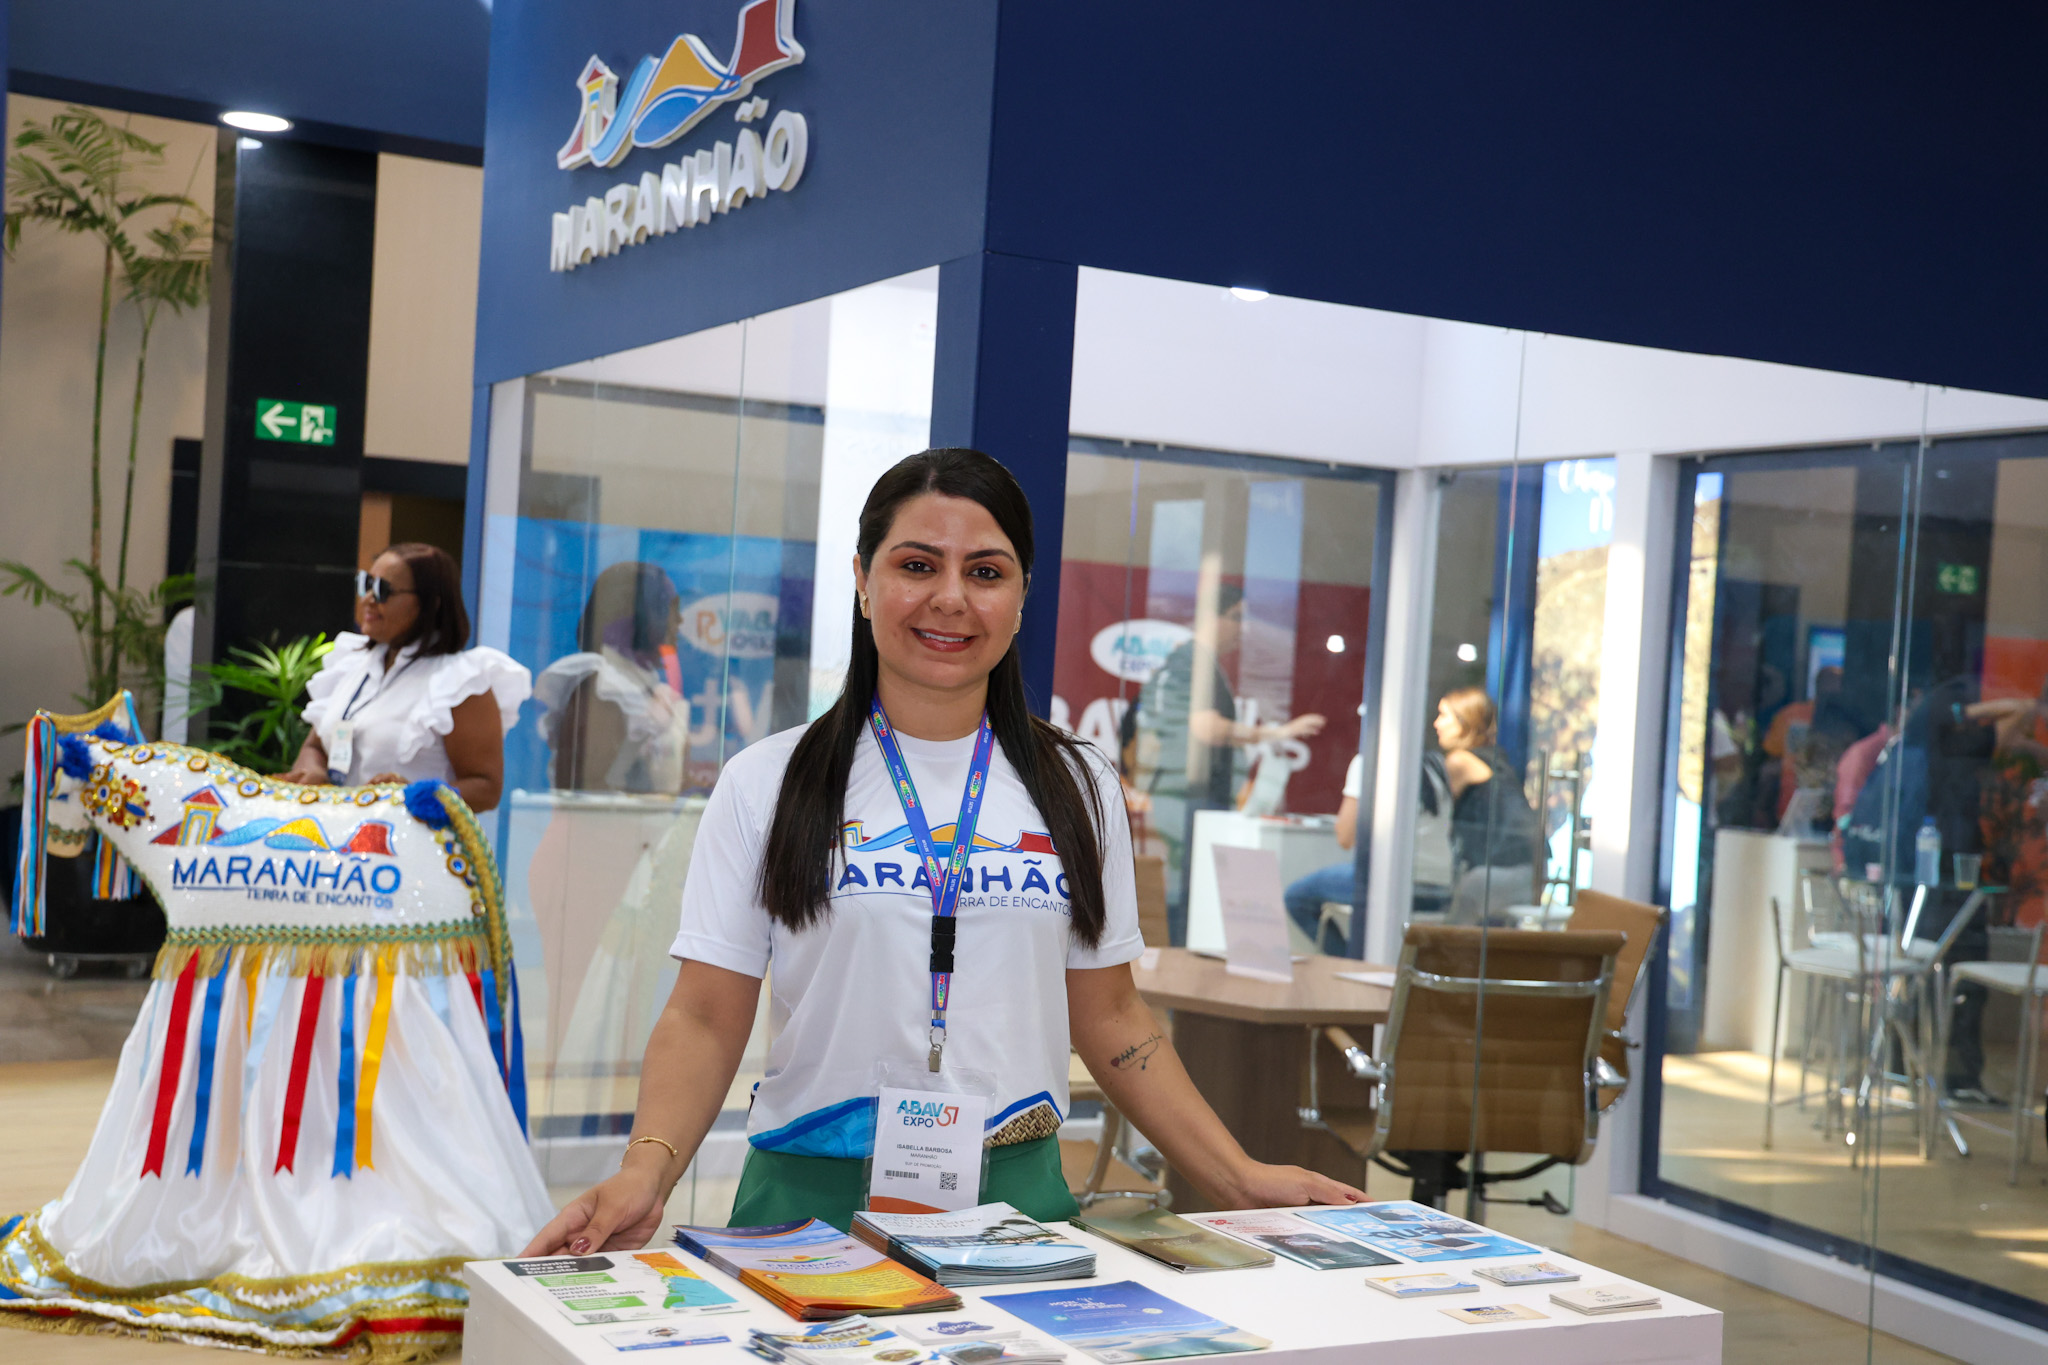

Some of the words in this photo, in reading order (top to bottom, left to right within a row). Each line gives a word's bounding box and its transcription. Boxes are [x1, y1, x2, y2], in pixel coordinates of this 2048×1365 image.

[551, 96, 808, 272] MARANHÃO
[172, 855, 402, 894] MARANHÃO
[246, 888, 290, 902] TERRA
[293, 890, 310, 904] DE
[316, 892, 394, 910] ENCANTOS
[989, 896, 1008, 907] DE
[1012, 896, 1072, 917] ENCANTOS
[896, 1099, 944, 1118] ABAV
[903, 1116, 934, 1128] EXPO
[925, 1146, 953, 1154] BARBOSA
